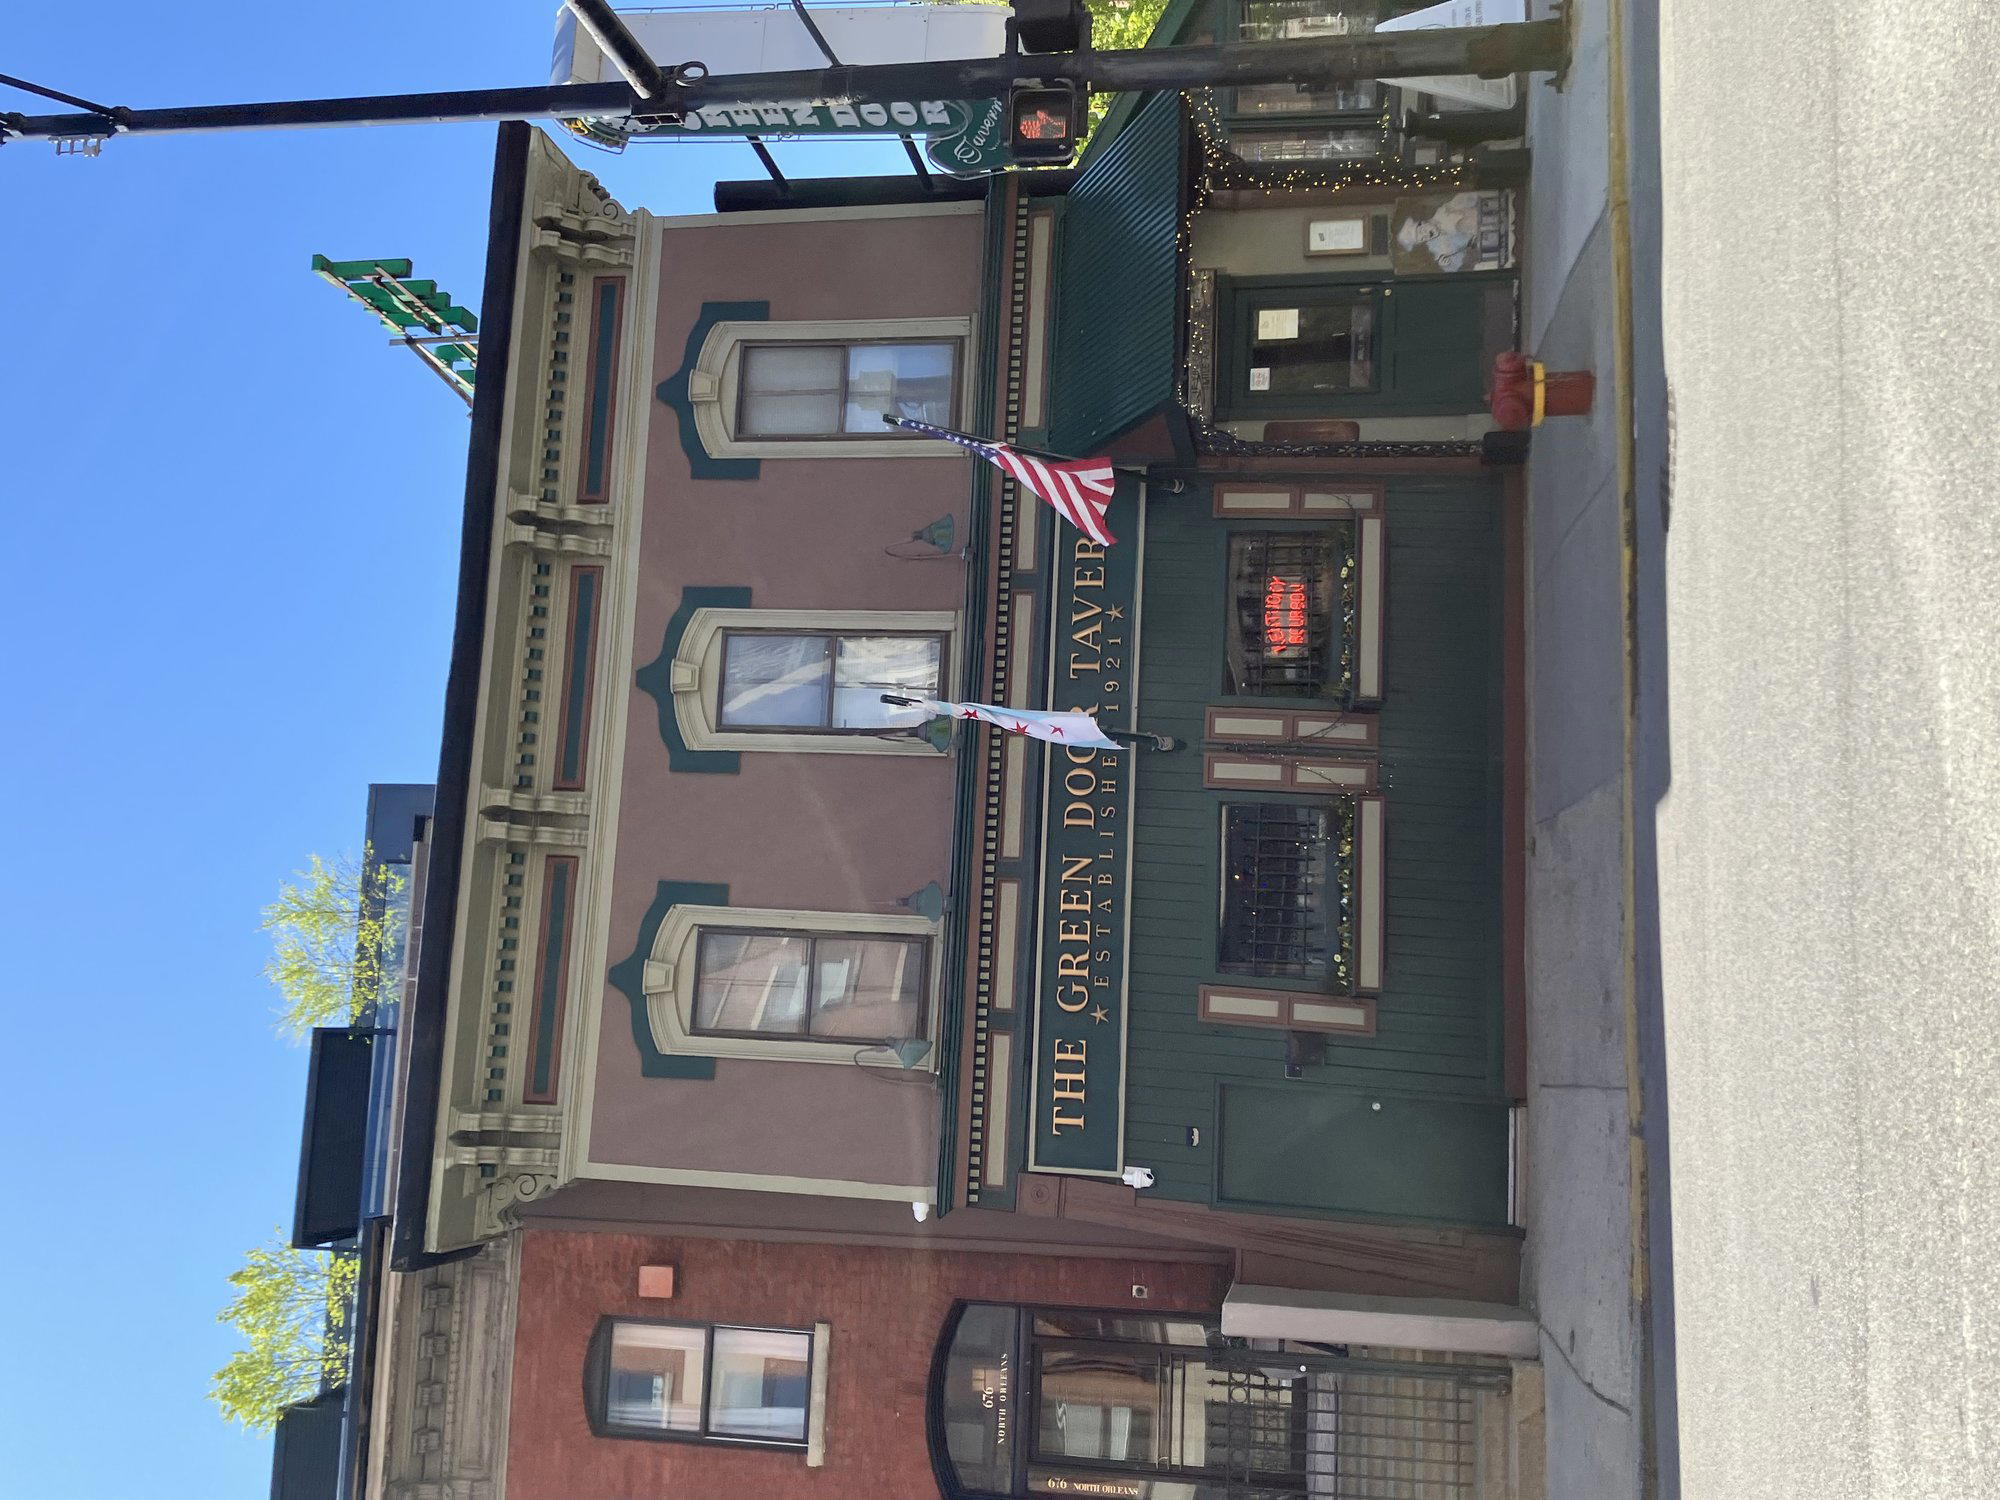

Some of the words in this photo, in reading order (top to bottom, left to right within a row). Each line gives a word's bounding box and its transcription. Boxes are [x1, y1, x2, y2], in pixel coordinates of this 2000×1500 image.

[828, 100, 950, 128] DOOR
[954, 97, 1002, 164] Tavern
[1069, 525, 1106, 679] TAVER
[1104, 636, 1122, 712] 1921
[1094, 739, 1118, 988] ESTABLISHE
[1056, 852, 1094, 1013] GREEN
[1052, 1038, 1087, 1136] THE
[982, 1386, 994, 1408] 676
[998, 1352, 1008, 1402] ORLEANS
[997, 1408, 1006, 1444] NORTH
[1047, 1478, 1068, 1488] 676
